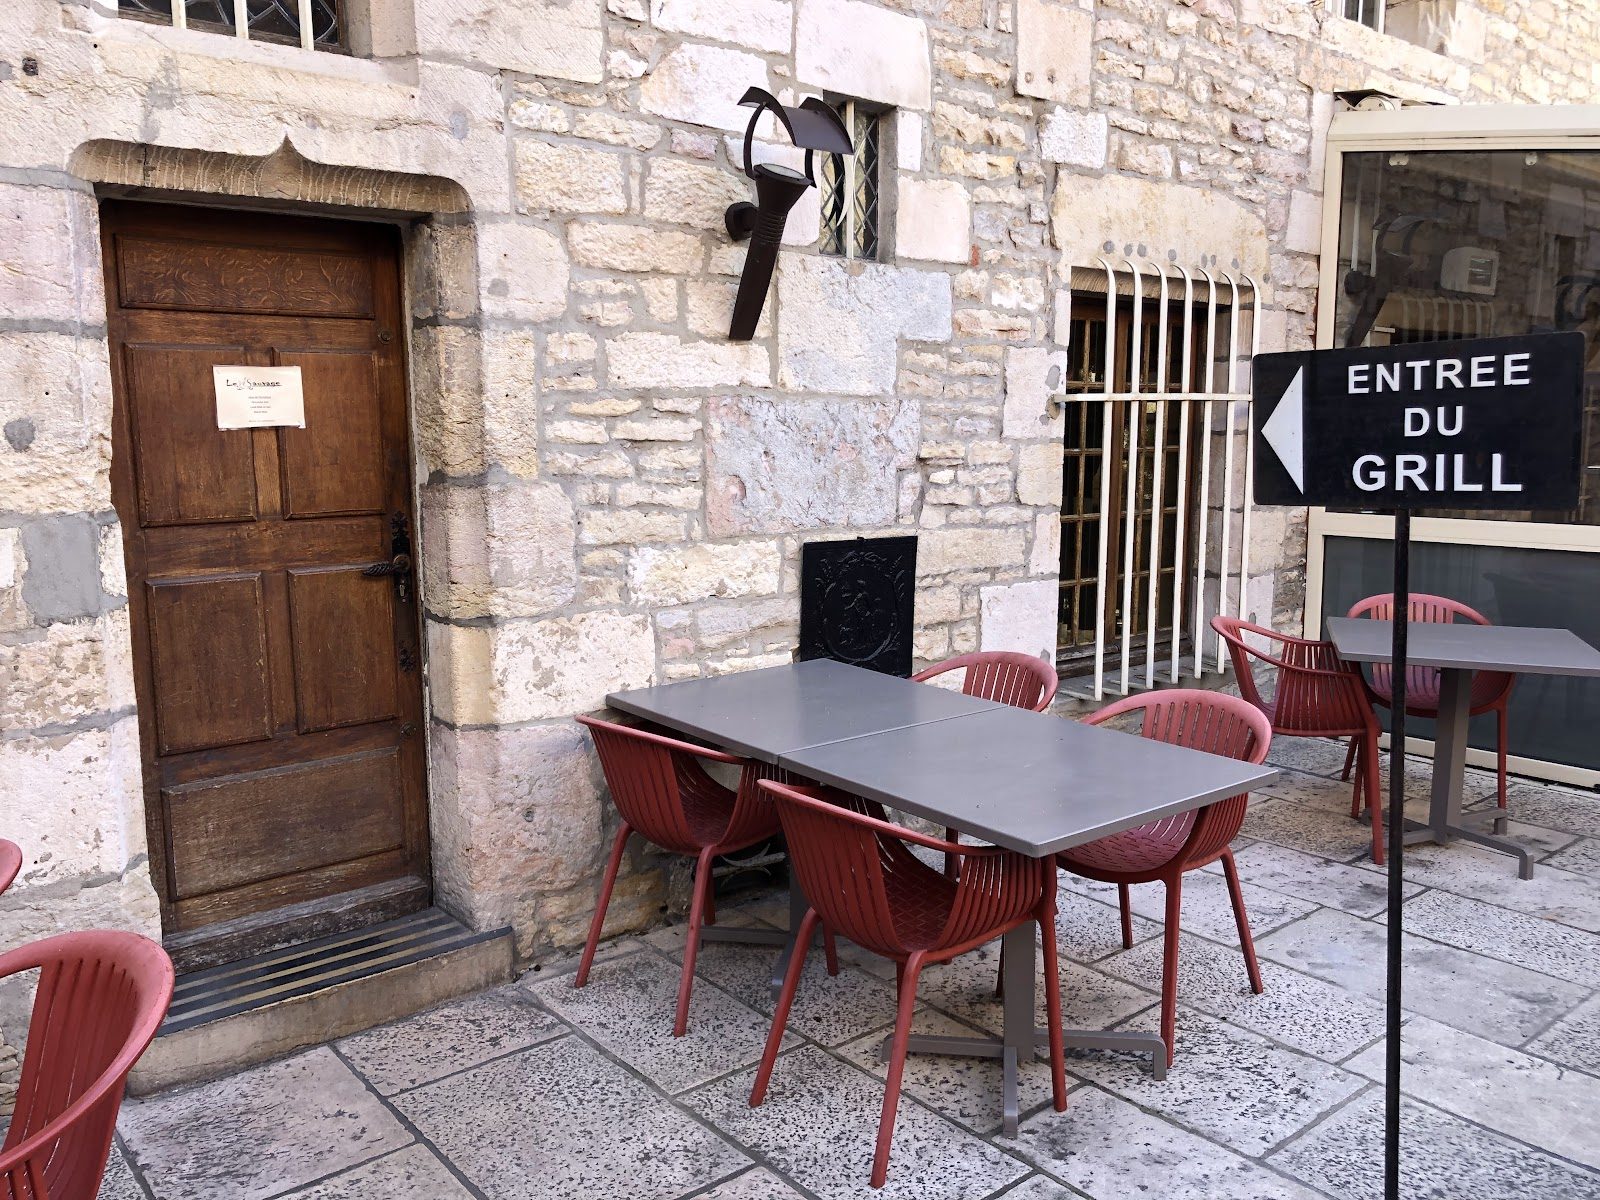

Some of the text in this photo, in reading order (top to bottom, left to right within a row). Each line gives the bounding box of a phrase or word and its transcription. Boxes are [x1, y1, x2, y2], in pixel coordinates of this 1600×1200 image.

[1348, 352, 1531, 394] ENTREE
[1404, 405, 1463, 437] DU
[1352, 453, 1523, 492] GRILL
